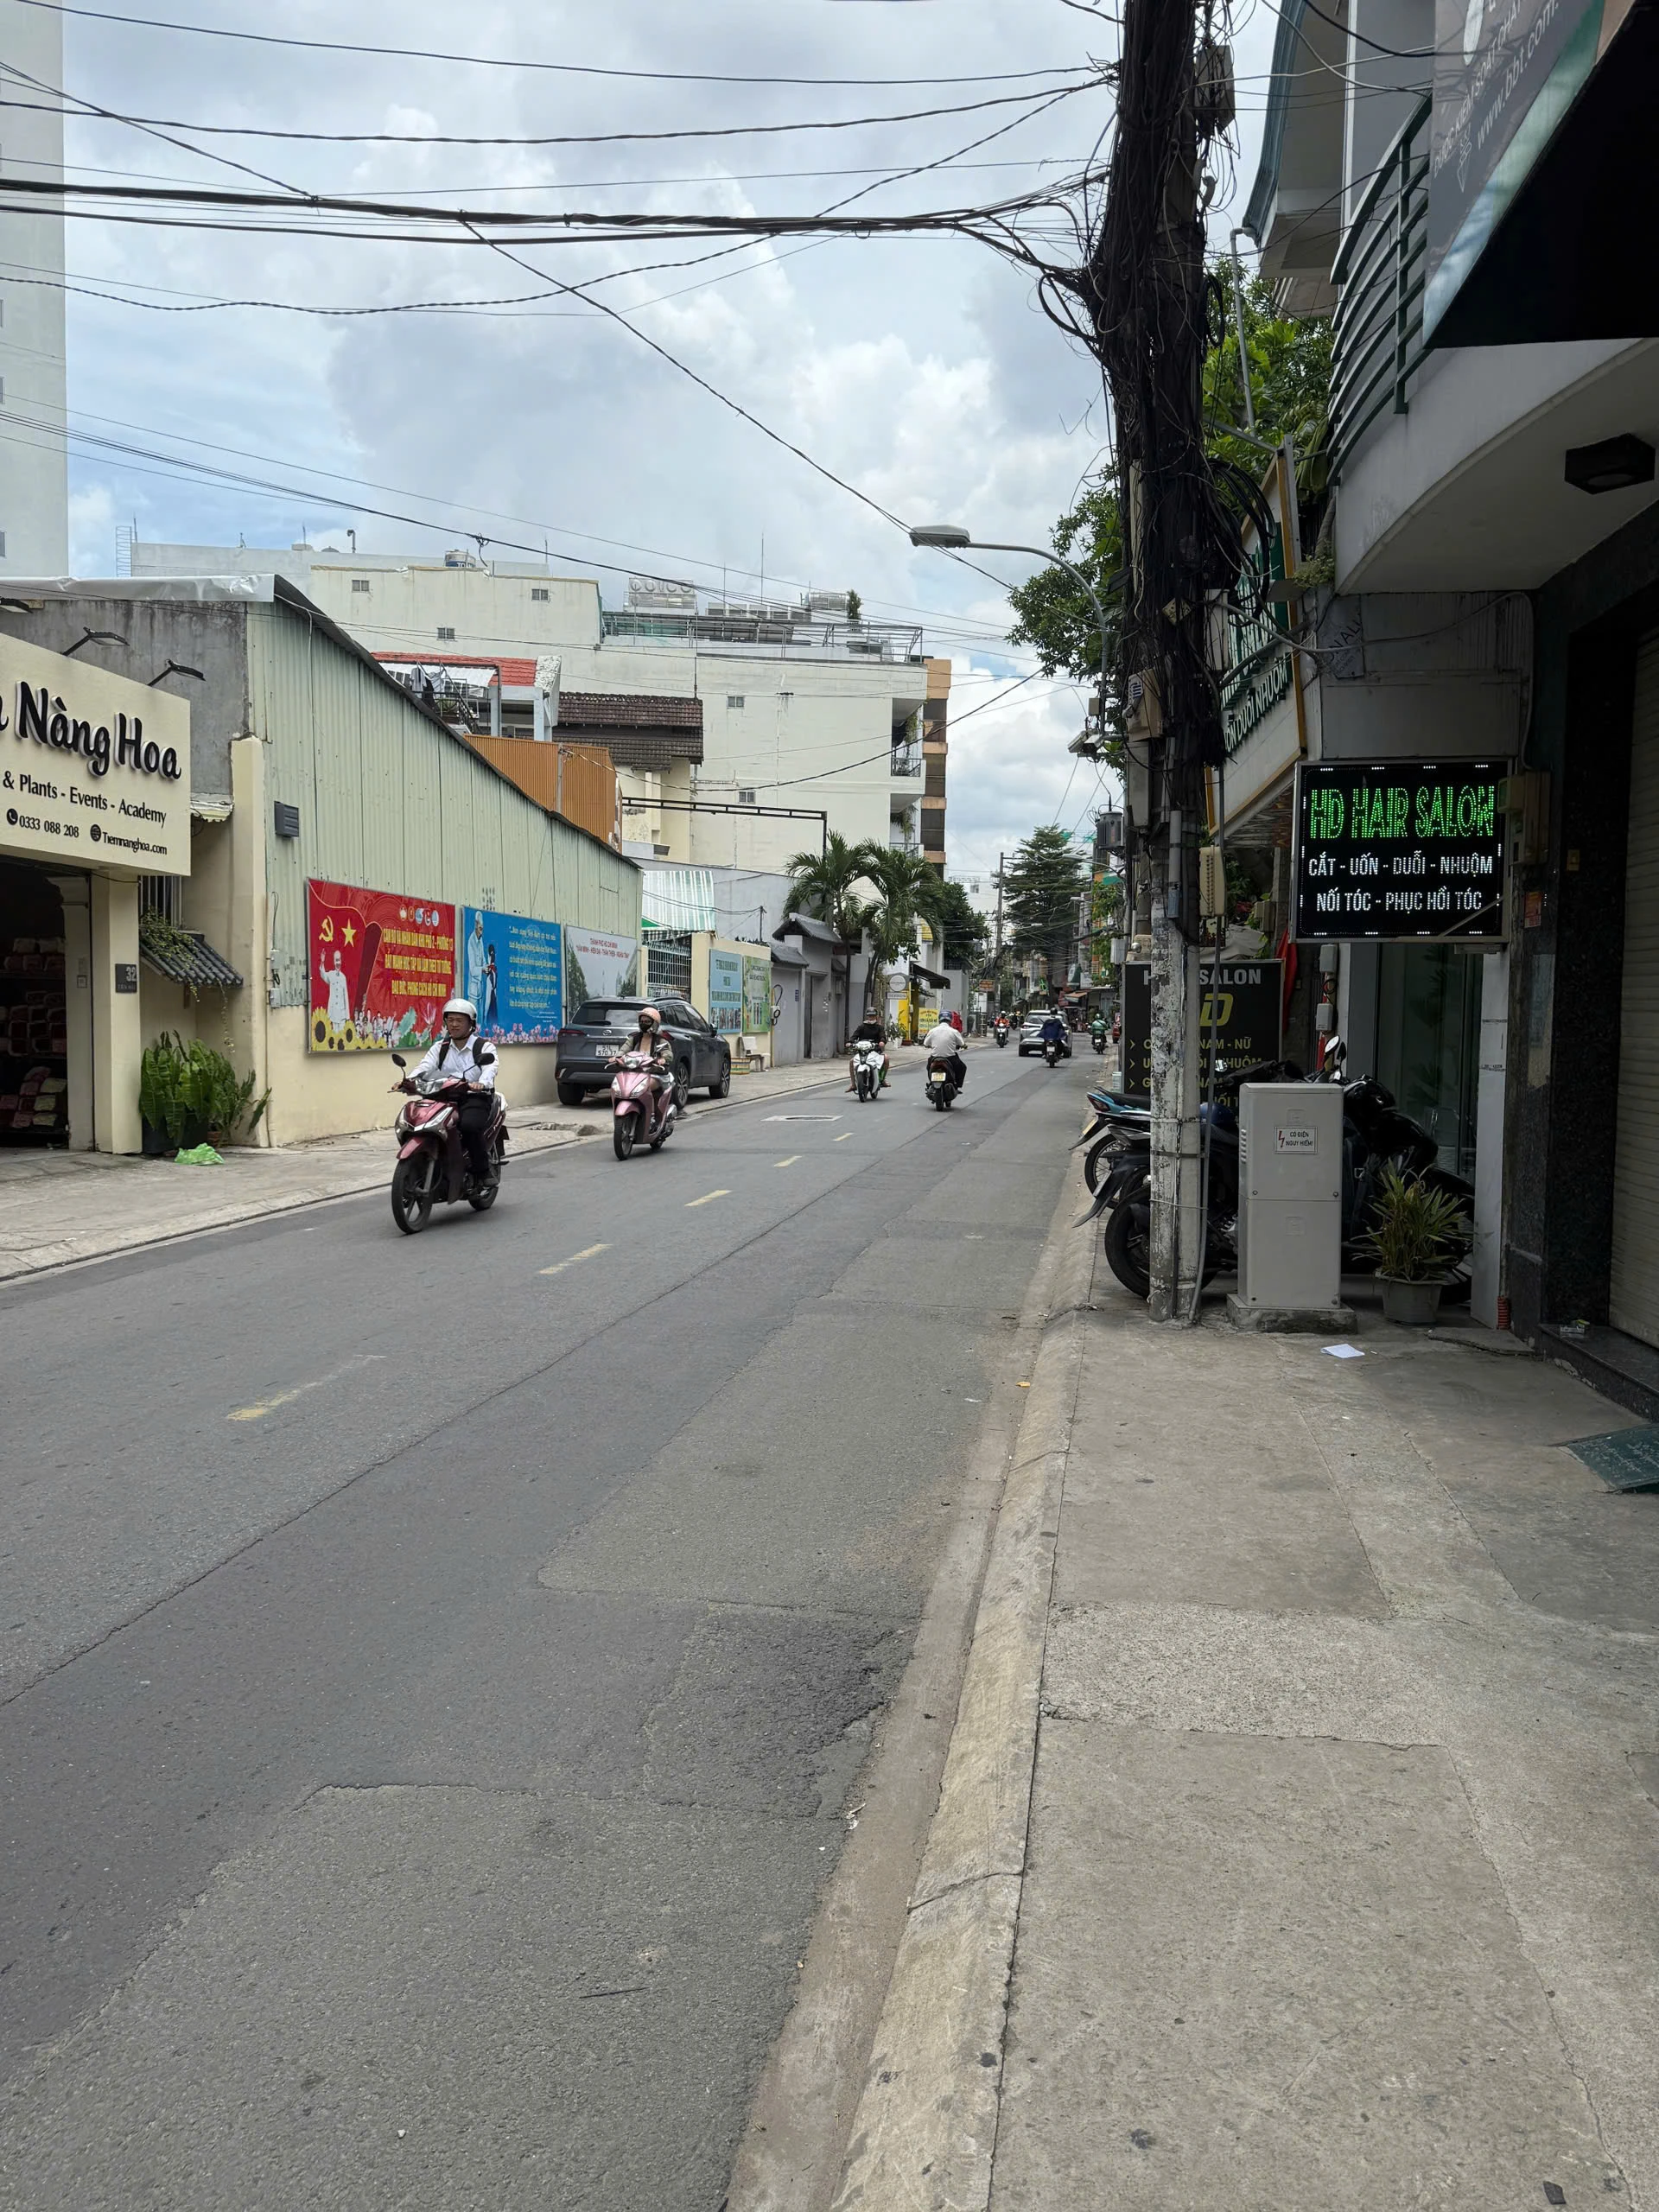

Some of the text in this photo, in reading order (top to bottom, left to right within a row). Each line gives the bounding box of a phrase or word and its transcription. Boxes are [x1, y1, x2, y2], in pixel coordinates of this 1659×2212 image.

[16, 681, 111, 776] Nàng
[115, 713, 181, 779] Hoa
[3, 771, 15, 790] &
[20, 774, 58, 799] Plants
[70, 786, 108, 810] Events
[118, 798, 167, 829] Academy
[1310, 785, 1495, 839] HD HAIR SALON
[19, 815, 41, 830] 0333
[44, 820, 61, 835] 088
[63, 824, 79, 838] 208
[1308, 851, 1337, 876] CẮT
[1350, 852, 1379, 875] UỐN
[1392, 850, 1426, 874] DUỖI
[1440, 852, 1493, 878] NHUỘM
[1316, 887, 1340, 912] NỐI
[1344, 888, 1371, 912] TÓC
[1385, 892, 1422, 914] PHỤC
[1427, 886, 1450, 910] HỒI
[1455, 887, 1482, 910] TÓC
